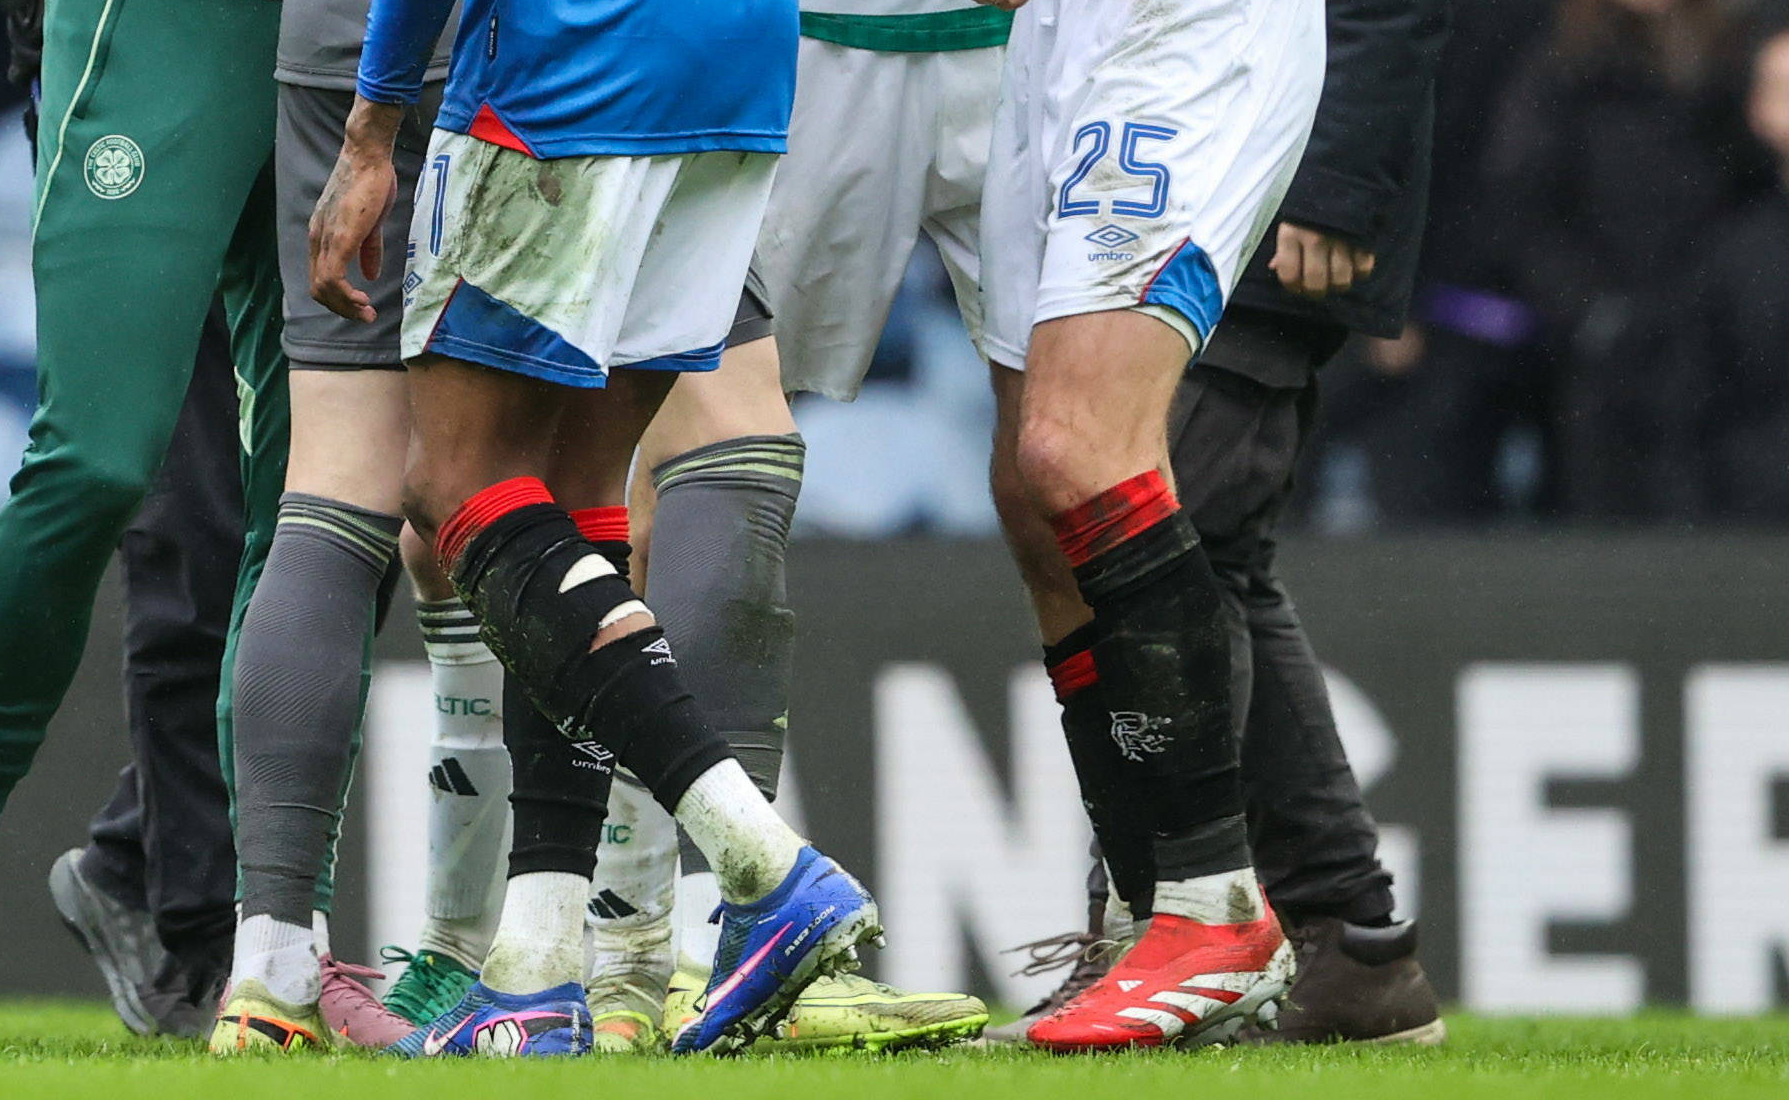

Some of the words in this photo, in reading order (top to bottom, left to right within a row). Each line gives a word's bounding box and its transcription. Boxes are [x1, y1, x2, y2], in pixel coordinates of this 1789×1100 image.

[1057, 120, 1179, 220] 25
[1087, 250, 1134, 262] umbro
[434, 692, 491, 716] LTIC
